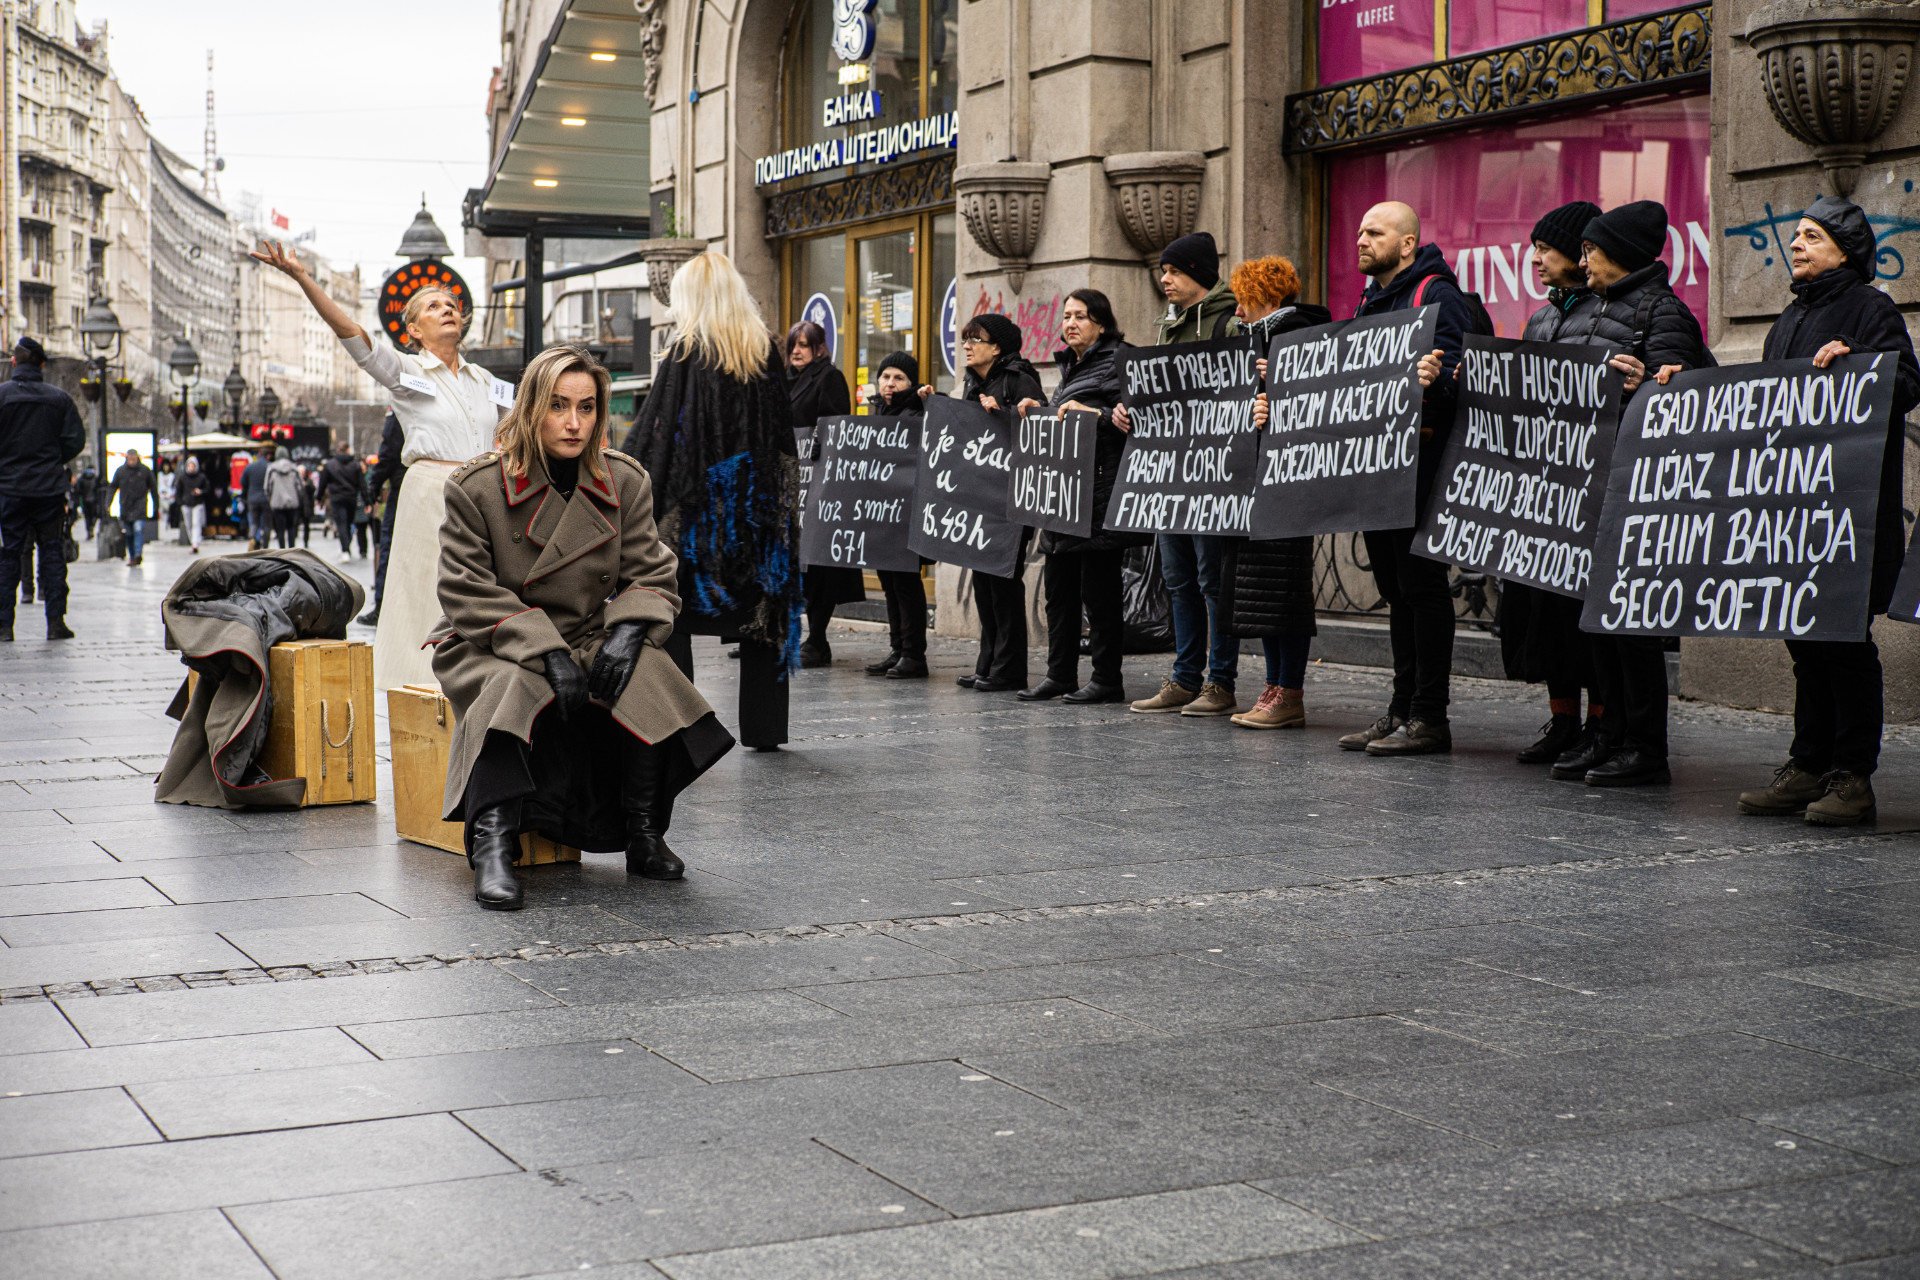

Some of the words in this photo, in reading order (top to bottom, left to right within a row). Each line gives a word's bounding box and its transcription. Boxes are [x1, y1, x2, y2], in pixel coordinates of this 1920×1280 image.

[1356, 4, 1395, 29] KAFFEE
[823, 90, 875, 128] БАНКА
[755, 138, 840, 185] ПОШТАНСКА
[842, 110, 959, 165] ШТЕДИОНИЦА
[1273, 332, 1338, 385] FEVZIJA
[1341, 306, 1428, 372] ZEKOVIĆ
[1125, 355, 1171, 397] SAFET
[1269, 390, 1327, 436] NIJAZIM
[1329, 362, 1414, 425] KAJEVIĆ
[1463, 348, 1514, 397] RIFAT
[1520, 349, 1611, 409] HUSOVIĆ
[1641, 388, 1700, 439] ESAD
[1702, 352, 1883, 433] KAPETANOVIĆ
[836, 419, 910, 451] Beograda
[1186, 385, 1258, 436] TOPUZOVIĆ
[1465, 406, 1509, 457] HALIL
[1512, 406, 1597, 471] ZUPČEVIĆ
[928, 424, 955, 469] je
[1125, 448, 1176, 484] RASIM
[1182, 434, 1233, 484] ĆORIĆ
[1262, 443, 1340, 487] ZVJEZDAN
[1340, 412, 1418, 477] ZULIČIĆ
[1628, 448, 1716, 503] ILIJAZ
[1727, 428, 1835, 498] LIČINA
[936, 469, 958, 493] u
[1014, 464, 1081, 524] UBIJENI
[1445, 461, 1513, 515] SENAD
[853, 498, 905, 523] smrti
[1114, 491, 1186, 531] FIKRET
[1618, 511, 1716, 567] FEHIM
[1721, 500, 1857, 565] BAKIJA
[830, 528, 867, 566] 671
[1427, 507, 1500, 567] JUSUF
[1497, 528, 1593, 592] RASTODER
[1600, 565, 1684, 632] ŠEĆO
[1694, 564, 1820, 636] SOFTIĆ
